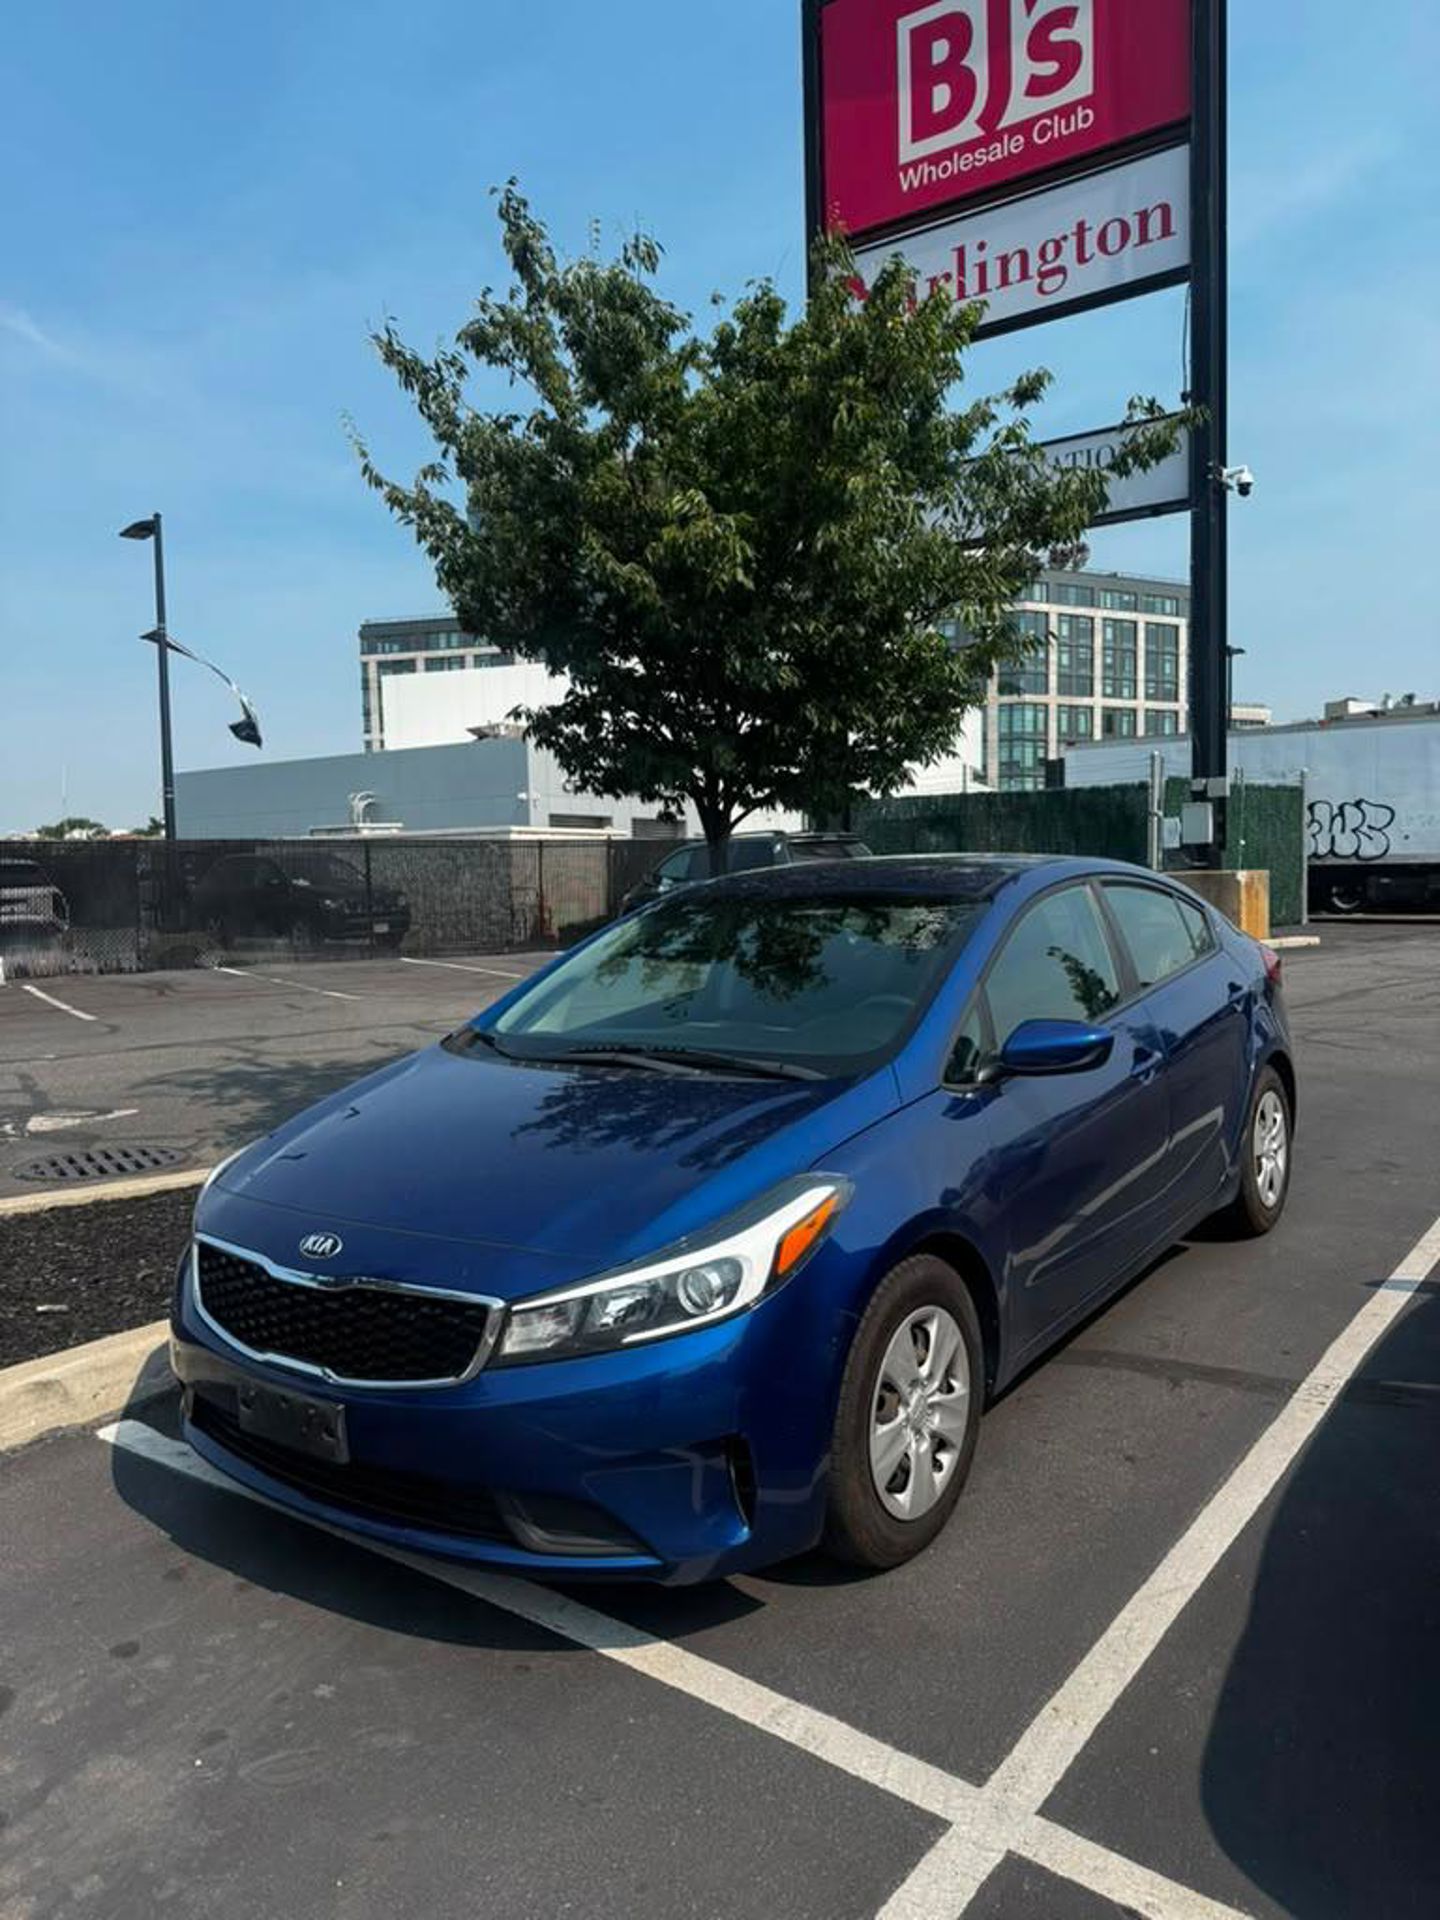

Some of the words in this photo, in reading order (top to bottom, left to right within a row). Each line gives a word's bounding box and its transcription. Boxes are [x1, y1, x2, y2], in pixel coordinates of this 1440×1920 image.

[899, 133, 1025, 193] Wholesale
[1032, 104, 1095, 145] Club
[843, 199, 1177, 313] rlington
[302, 1234, 335, 1254] KIA
